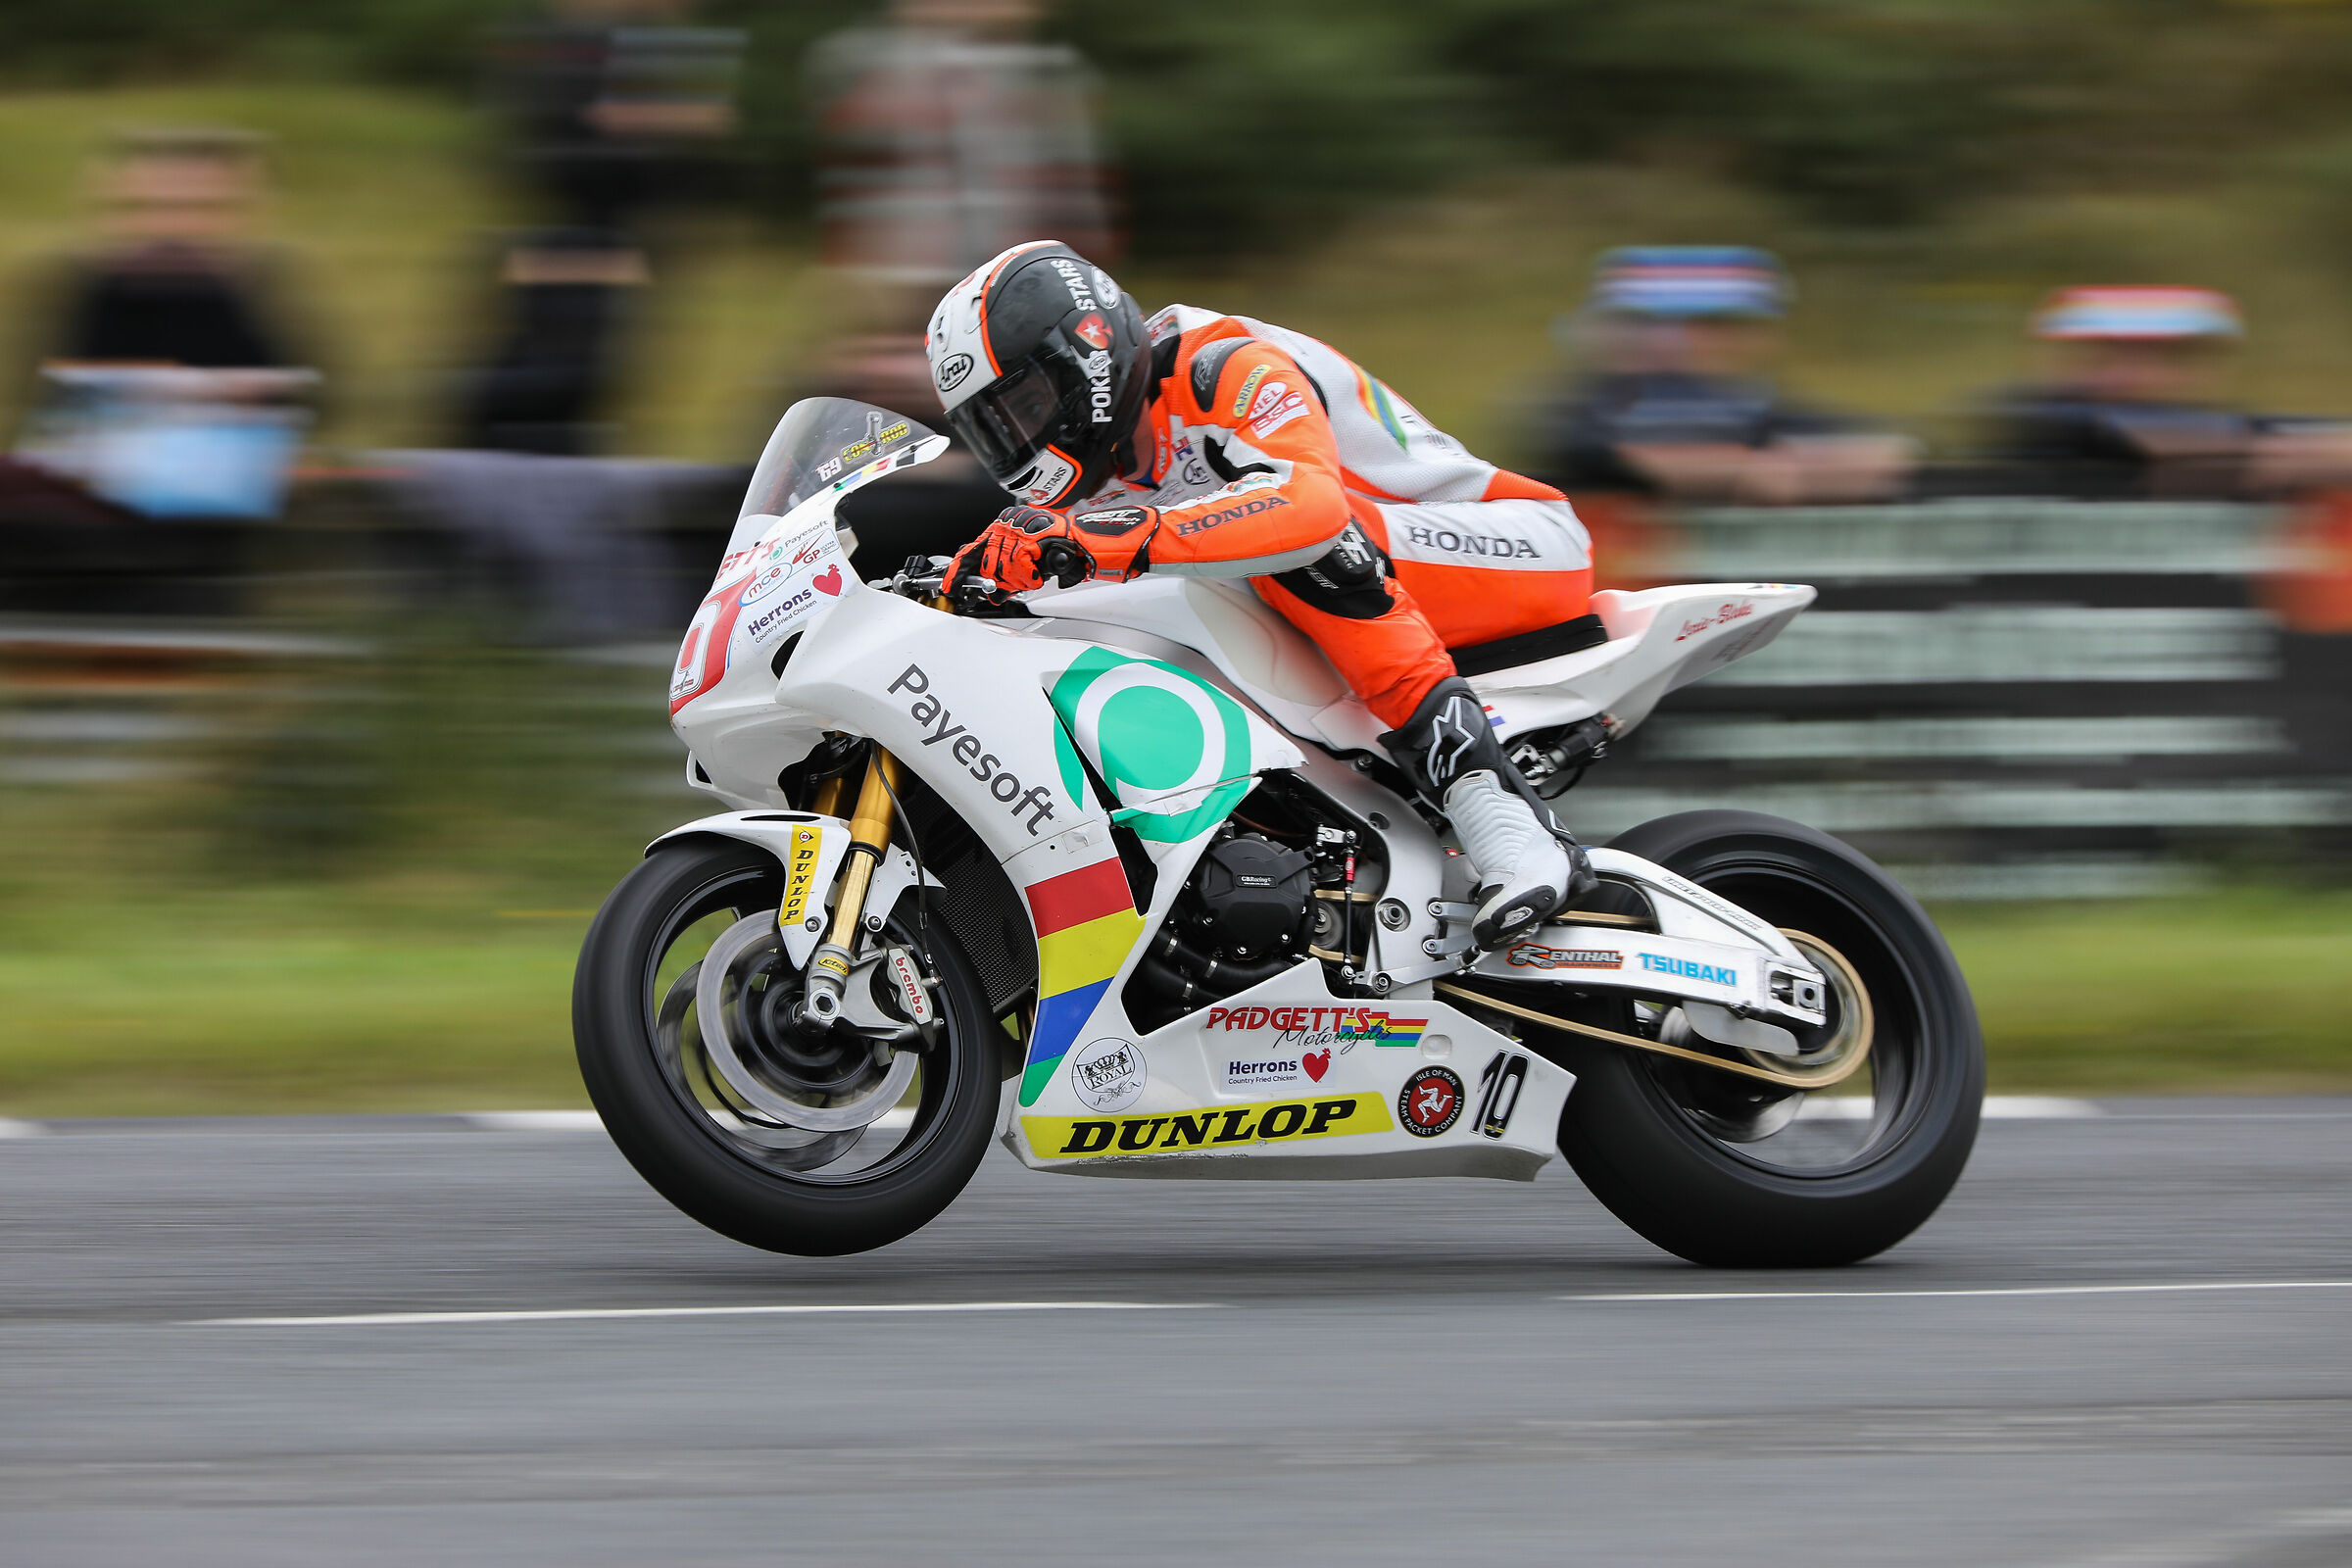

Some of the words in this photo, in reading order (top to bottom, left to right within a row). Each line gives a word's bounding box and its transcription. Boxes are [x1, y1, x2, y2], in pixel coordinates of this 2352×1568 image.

[1051, 259, 1098, 311] STARS
[1252, 390, 1282, 415] HEL
[1043, 466, 1067, 492] STARS
[785, 520, 828, 548] Payesoft
[1176, 497, 1291, 538] HONDA
[804, 549, 821, 564] GP
[1406, 524, 1542, 560] HONDA
[749, 567, 782, 598] mce
[748, 589, 812, 637] Herrons
[755, 622, 778, 644] Country
[777, 613, 794, 628] Fried
[793, 600, 817, 616] Chicken
[887, 663, 1056, 837] Payesoft
[784, 849, 814, 920] DUNLOP
[1511, 945, 1622, 968] RENTHAL
[1638, 953, 1737, 987] TSUBAKI
[895, 956, 924, 1014] brembo
[1206, 1006, 1370, 1032] PADGETT'S
[1273, 1019, 1394, 1055] Motorcycles
[1089, 1065, 1133, 1087] ROYAL
[1229, 1060, 1298, 1075] Herrons
[1415, 1070, 1430, 1082] ISLE
[1442, 1071, 1458, 1086] MAN
[1400, 1089, 1411, 1117] STEAM
[1470, 1050, 1530, 1142] 10
[1059, 1098, 1357, 1154] DUNLOP
[1404, 1117, 1433, 1135] PACKET
[1434, 1095, 1463, 1133] COMPANY
